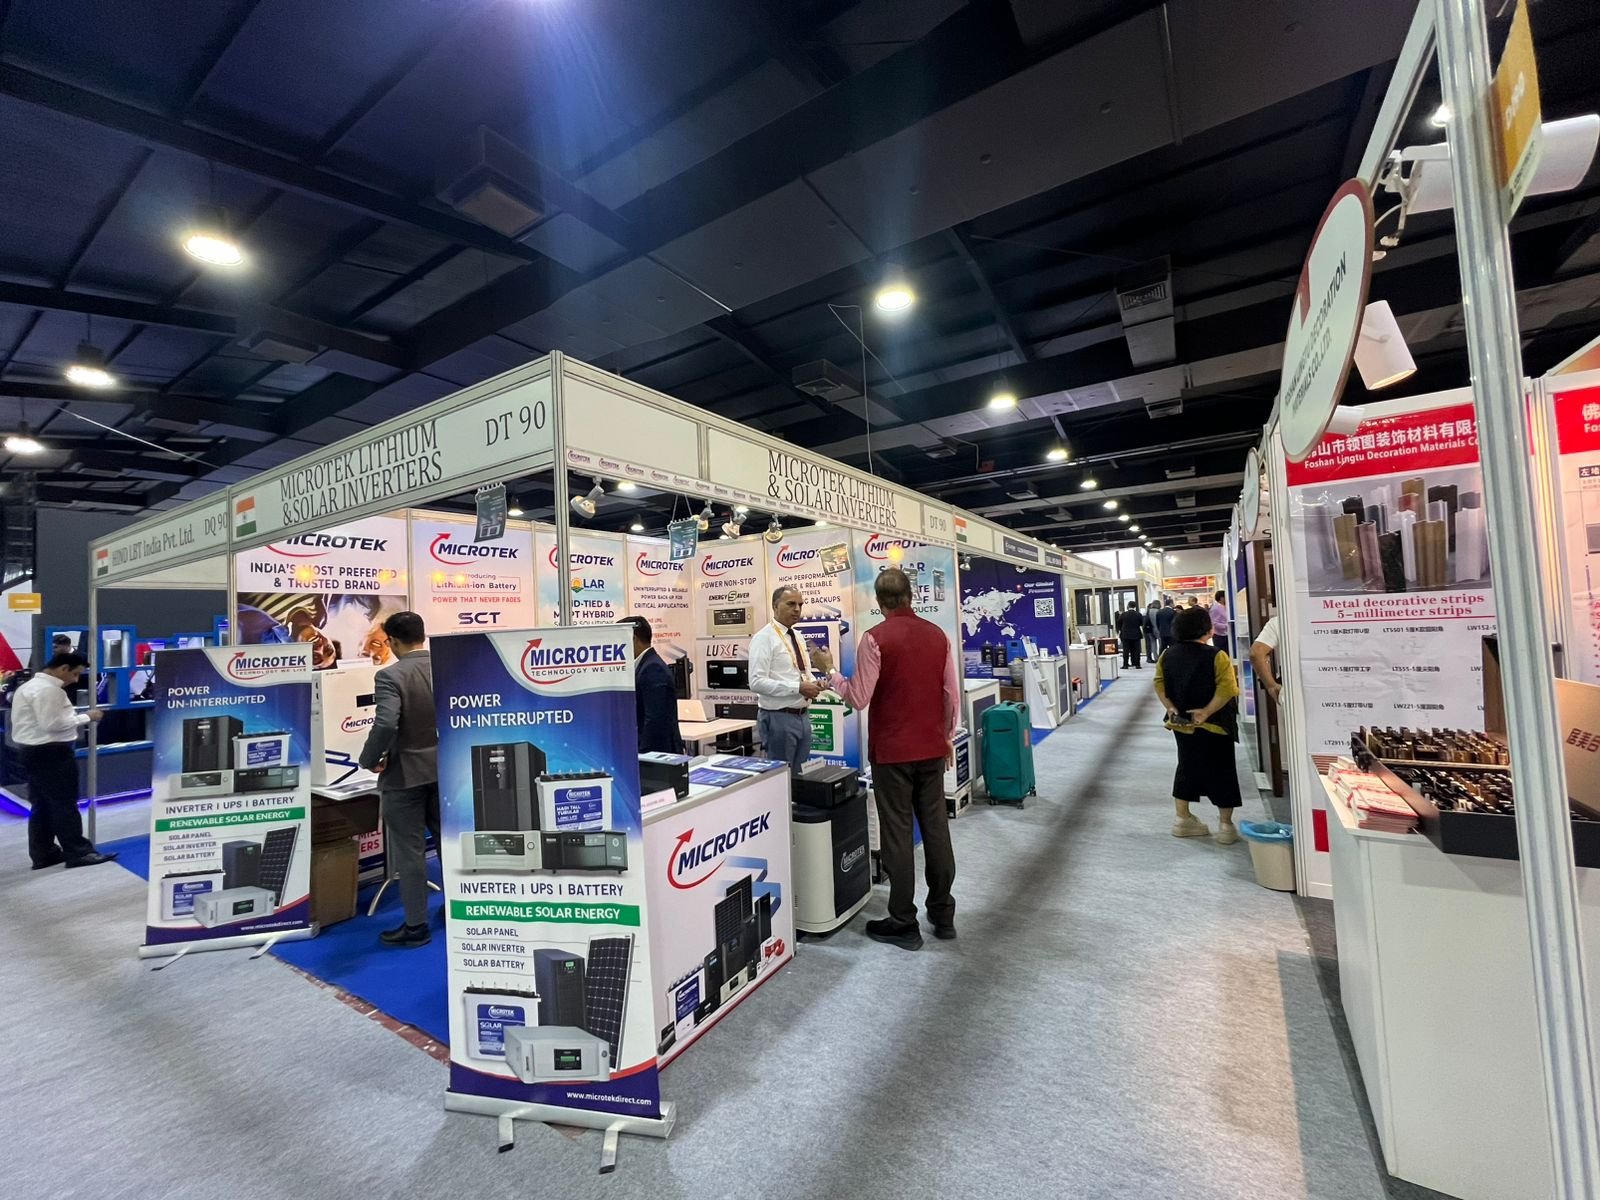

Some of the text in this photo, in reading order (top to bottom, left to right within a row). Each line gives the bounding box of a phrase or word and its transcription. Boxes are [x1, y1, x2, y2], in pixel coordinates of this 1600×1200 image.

[1311, 251, 1346, 349] DECORATION
[485, 401, 546, 446] DT 90
[1308, 419, 1479, 457] 山市领图装饰材料有限
[280, 420, 438, 502] MICROTEK LITHIUM
[1305, 458, 1334, 470] Foshan
[1337, 452, 1365, 466] Lingtu
[1367, 446, 1418, 460] Decoration
[1420, 439, 1466, 453] Materials
[342, 451, 443, 508] INVERTERS
[767, 449, 895, 510] MICROTEK LITHIUM
[767, 474, 781, 499] &
[785, 479, 834, 512] SOLAR
[836, 494, 898, 528] INVERTERS
[205, 512, 228, 536] DQ 90
[929, 515, 947, 531] DT 90
[144, 536, 161, 557] India
[163, 533, 178, 551] Pvt.
[179, 524, 195, 546] Ltd.
[287, 533, 388, 551] ICROTEK
[438, 543, 519, 559] MICROTEK
[555, 554, 614, 567] CROTEK
[640, 559, 684, 572] MICROTEK
[706, 557, 753, 571] MICROTEK
[250, 562, 296, 575] INDIA'S
[274, 578, 381, 591] & TRUSTED BRAND
[489, 583, 517, 591] Battery
[701, 577, 757, 589] POWER NON-STOP
[605, 600, 610, 608] &
[811, 596, 841, 604] BACKUPS
[1323, 593, 1484, 609] Metal decorative strips
[458, 612, 501, 625] SCT
[1337, 605, 1472, 619] 5-millimeter strips
[530, 643, 627, 666] MICROTEK
[706, 644, 739, 657] LUXE
[235, 655, 307, 669] MICROTEK
[531, 667, 588, 677] TECHNOLOGY
[168, 686, 210, 697] POWER
[167, 695, 266, 709] UN-INTERRUPTED
[450, 694, 501, 710] POWER
[450, 710, 574, 729] UN-INTERRUPTED
[166, 796, 295, 815] INVERTER UPS BATTERY
[169, 810, 292, 829] RENEWABLE SOLAR ENERGY
[168, 831, 212, 841] SOLAR PANEL
[163, 841, 217, 852] SOLAR INVERTER
[677, 811, 771, 876] MICROTEK
[164, 852, 215, 862] SOLAR BATTERY
[460, 882, 624, 896] INVERTER UPS BATTERY
[466, 905, 620, 919] RENEWABLE SOLAR ENERGY
[466, 927, 519, 937] SOLAR PANEL
[462, 942, 525, 954] SOLAR INVERTER
[463, 958, 525, 970] SOLAR BATTERY
[566, 1090, 652, 1106] www.microtekdirect.com
